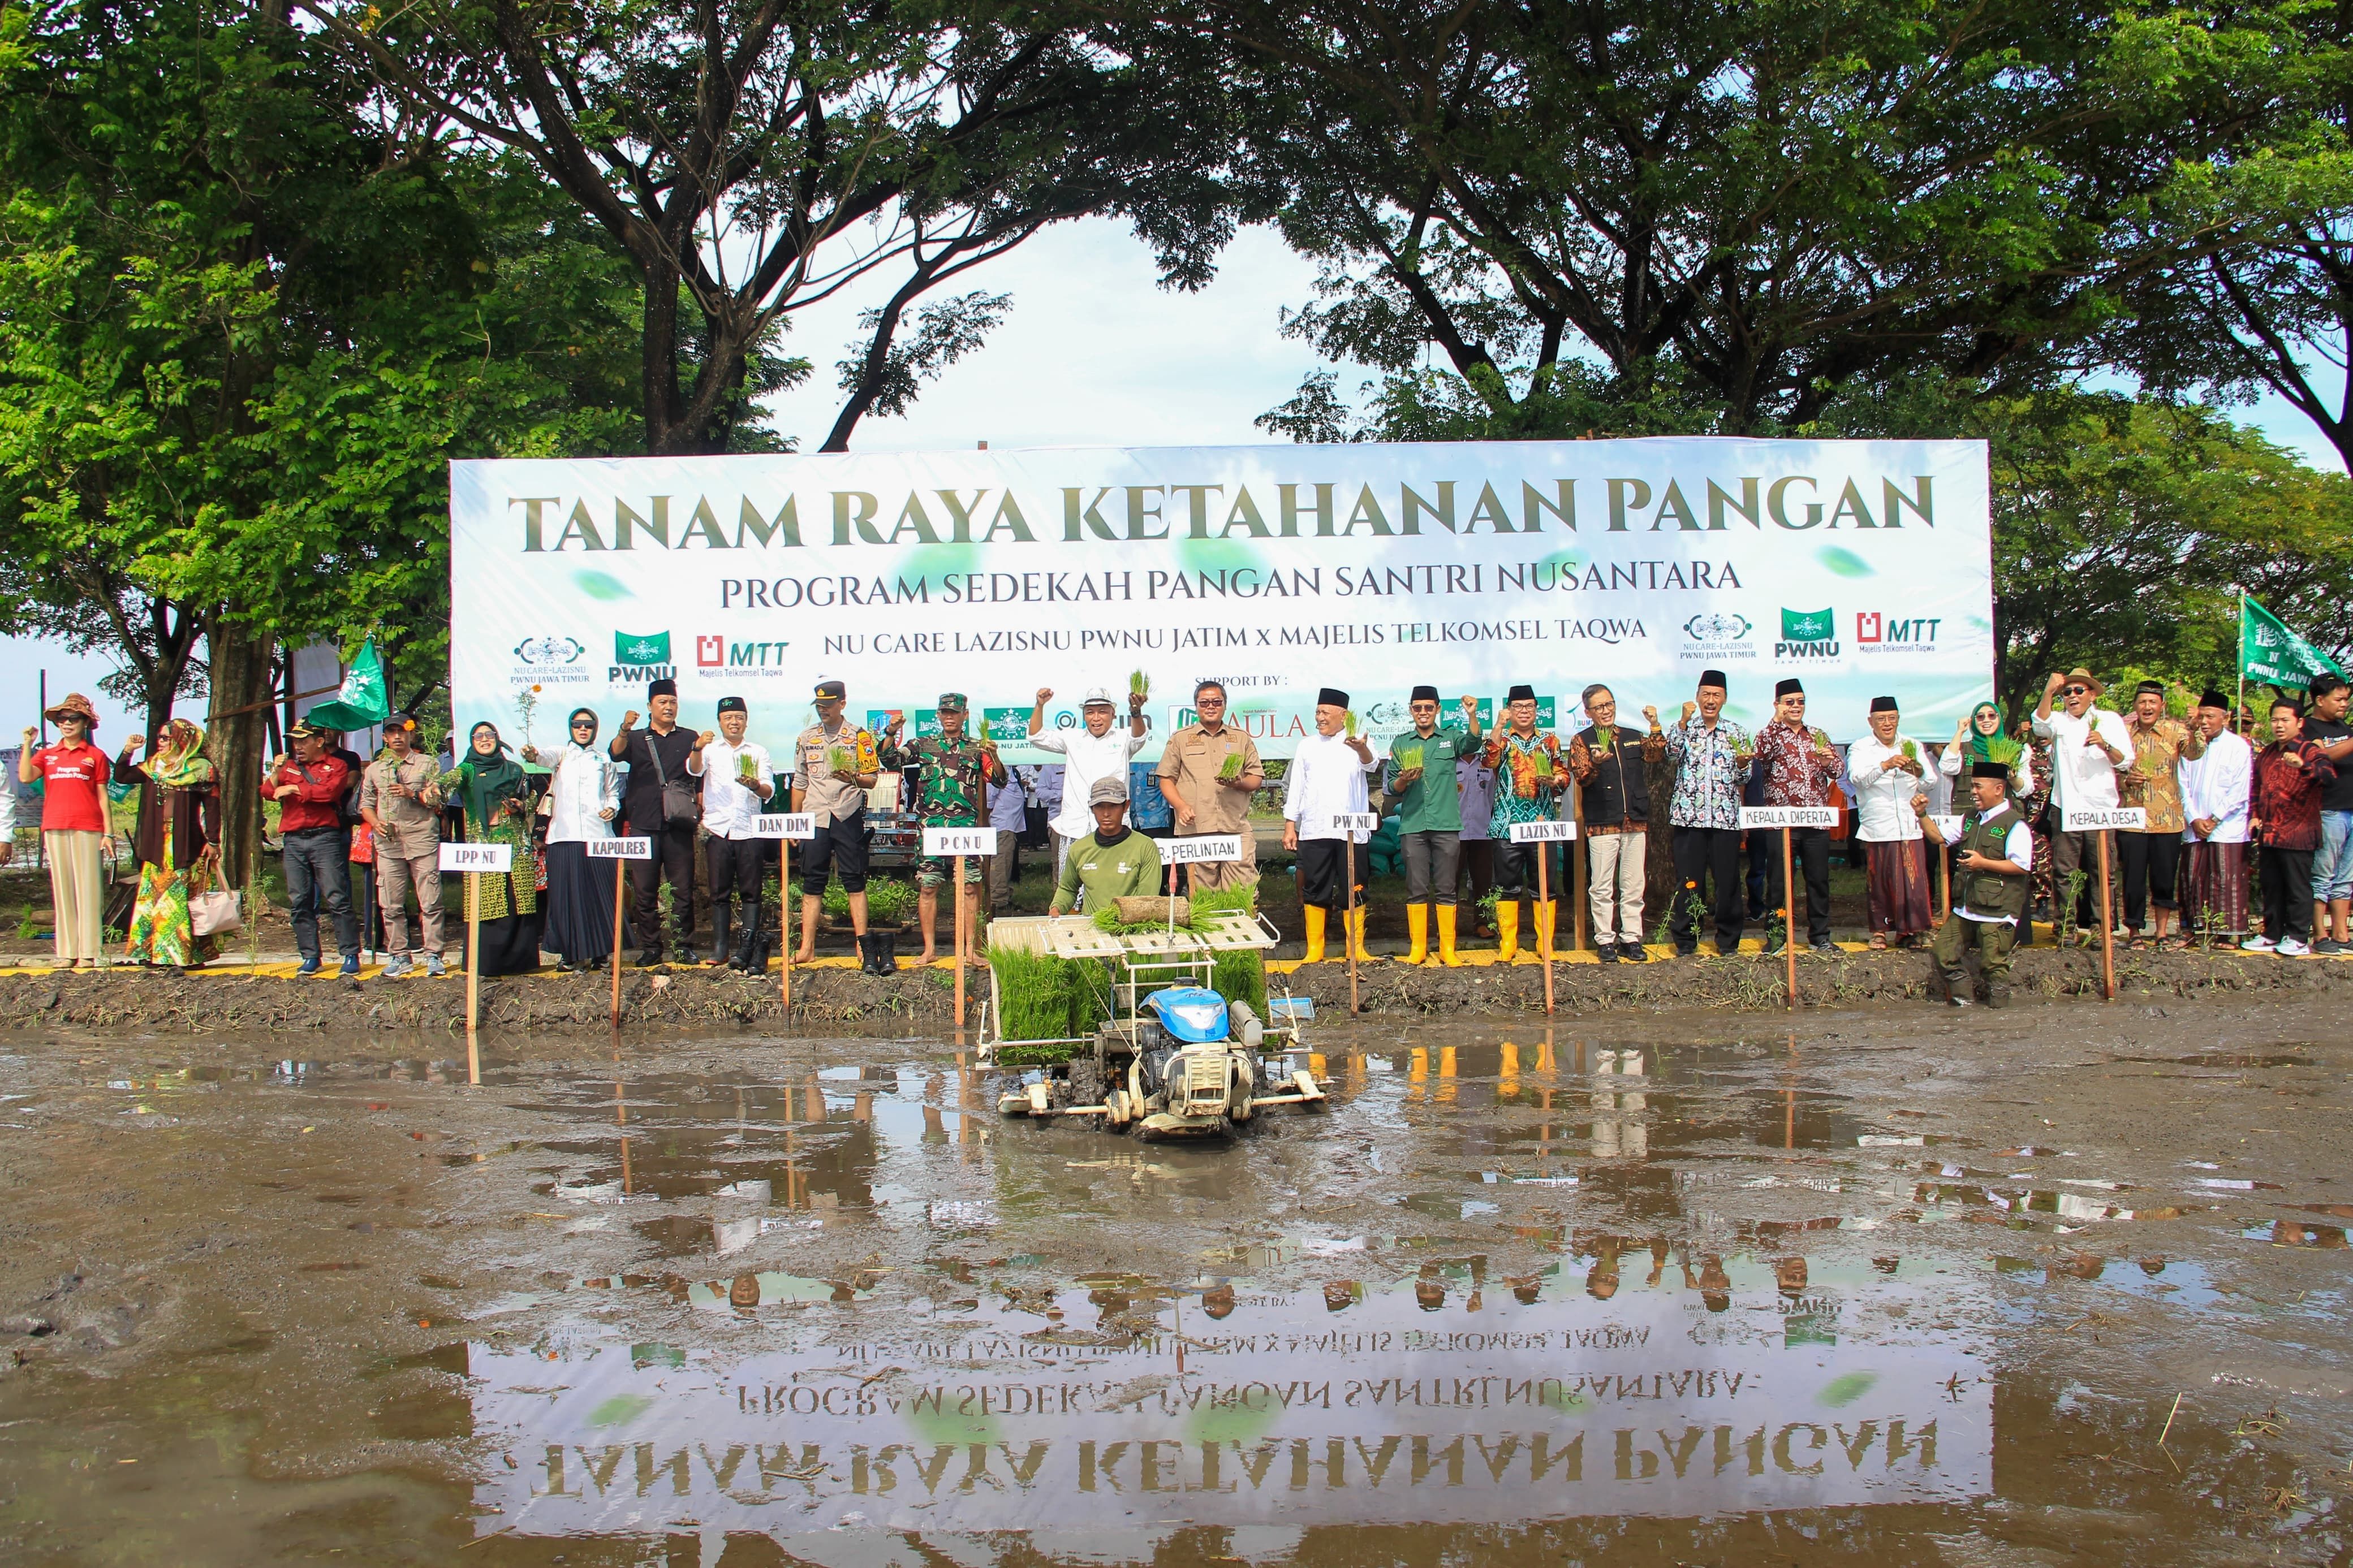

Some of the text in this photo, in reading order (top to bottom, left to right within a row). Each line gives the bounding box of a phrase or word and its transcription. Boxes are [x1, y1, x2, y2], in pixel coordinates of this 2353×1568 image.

[508, 475, 1937, 552] TANAM RAYA KETAHANAN PANGAN
[721, 560, 1743, 608] PROGRAM SEDEKAH PANGAN SANTRI NUSANTARA
[824, 634, 863, 655] NU
[873, 633, 946, 654] CARE
[954, 630, 1071, 652] LAZISNU
[1080, 629, 1163, 650] PWNU
[1171, 627, 1248, 653] JATIM
[1278, 623, 1385, 649] MAJELIS
[1390, 619, 1549, 644] TELKOMSEL
[1555, 617, 1648, 645] TAQWA
[1887, 619, 1941, 642] MTT
[730, 642, 790, 667] MTT
[1706, 651, 1727, 660] JAWA
[1774, 642, 1839, 658] PWNU
[1859, 643, 1935, 654] Majelis Telkomsel Taqwa
[609, 666, 677, 682] PWNU
[699, 668, 783, 679] Majelis Telkomsel Taqwa
[2247, 662, 2278, 679] PWNU
[538, 676, 560, 684] JAWA
[1264, 675, 1281, 686] BY
[1333, 815, 1371, 829] PW NU
[1746, 810, 1833, 824] KEPALA DIPERTA
[2070, 811, 2139, 826] KEPALA DESA
[759, 818, 809, 832] DAN DIM
[1519, 823, 1567, 839] LAZIS NU
[592, 840, 646, 855] KAPOLRES
[1172, 841, 1235, 858] PERLINTAN
[455, 850, 497, 864] LPP NU
